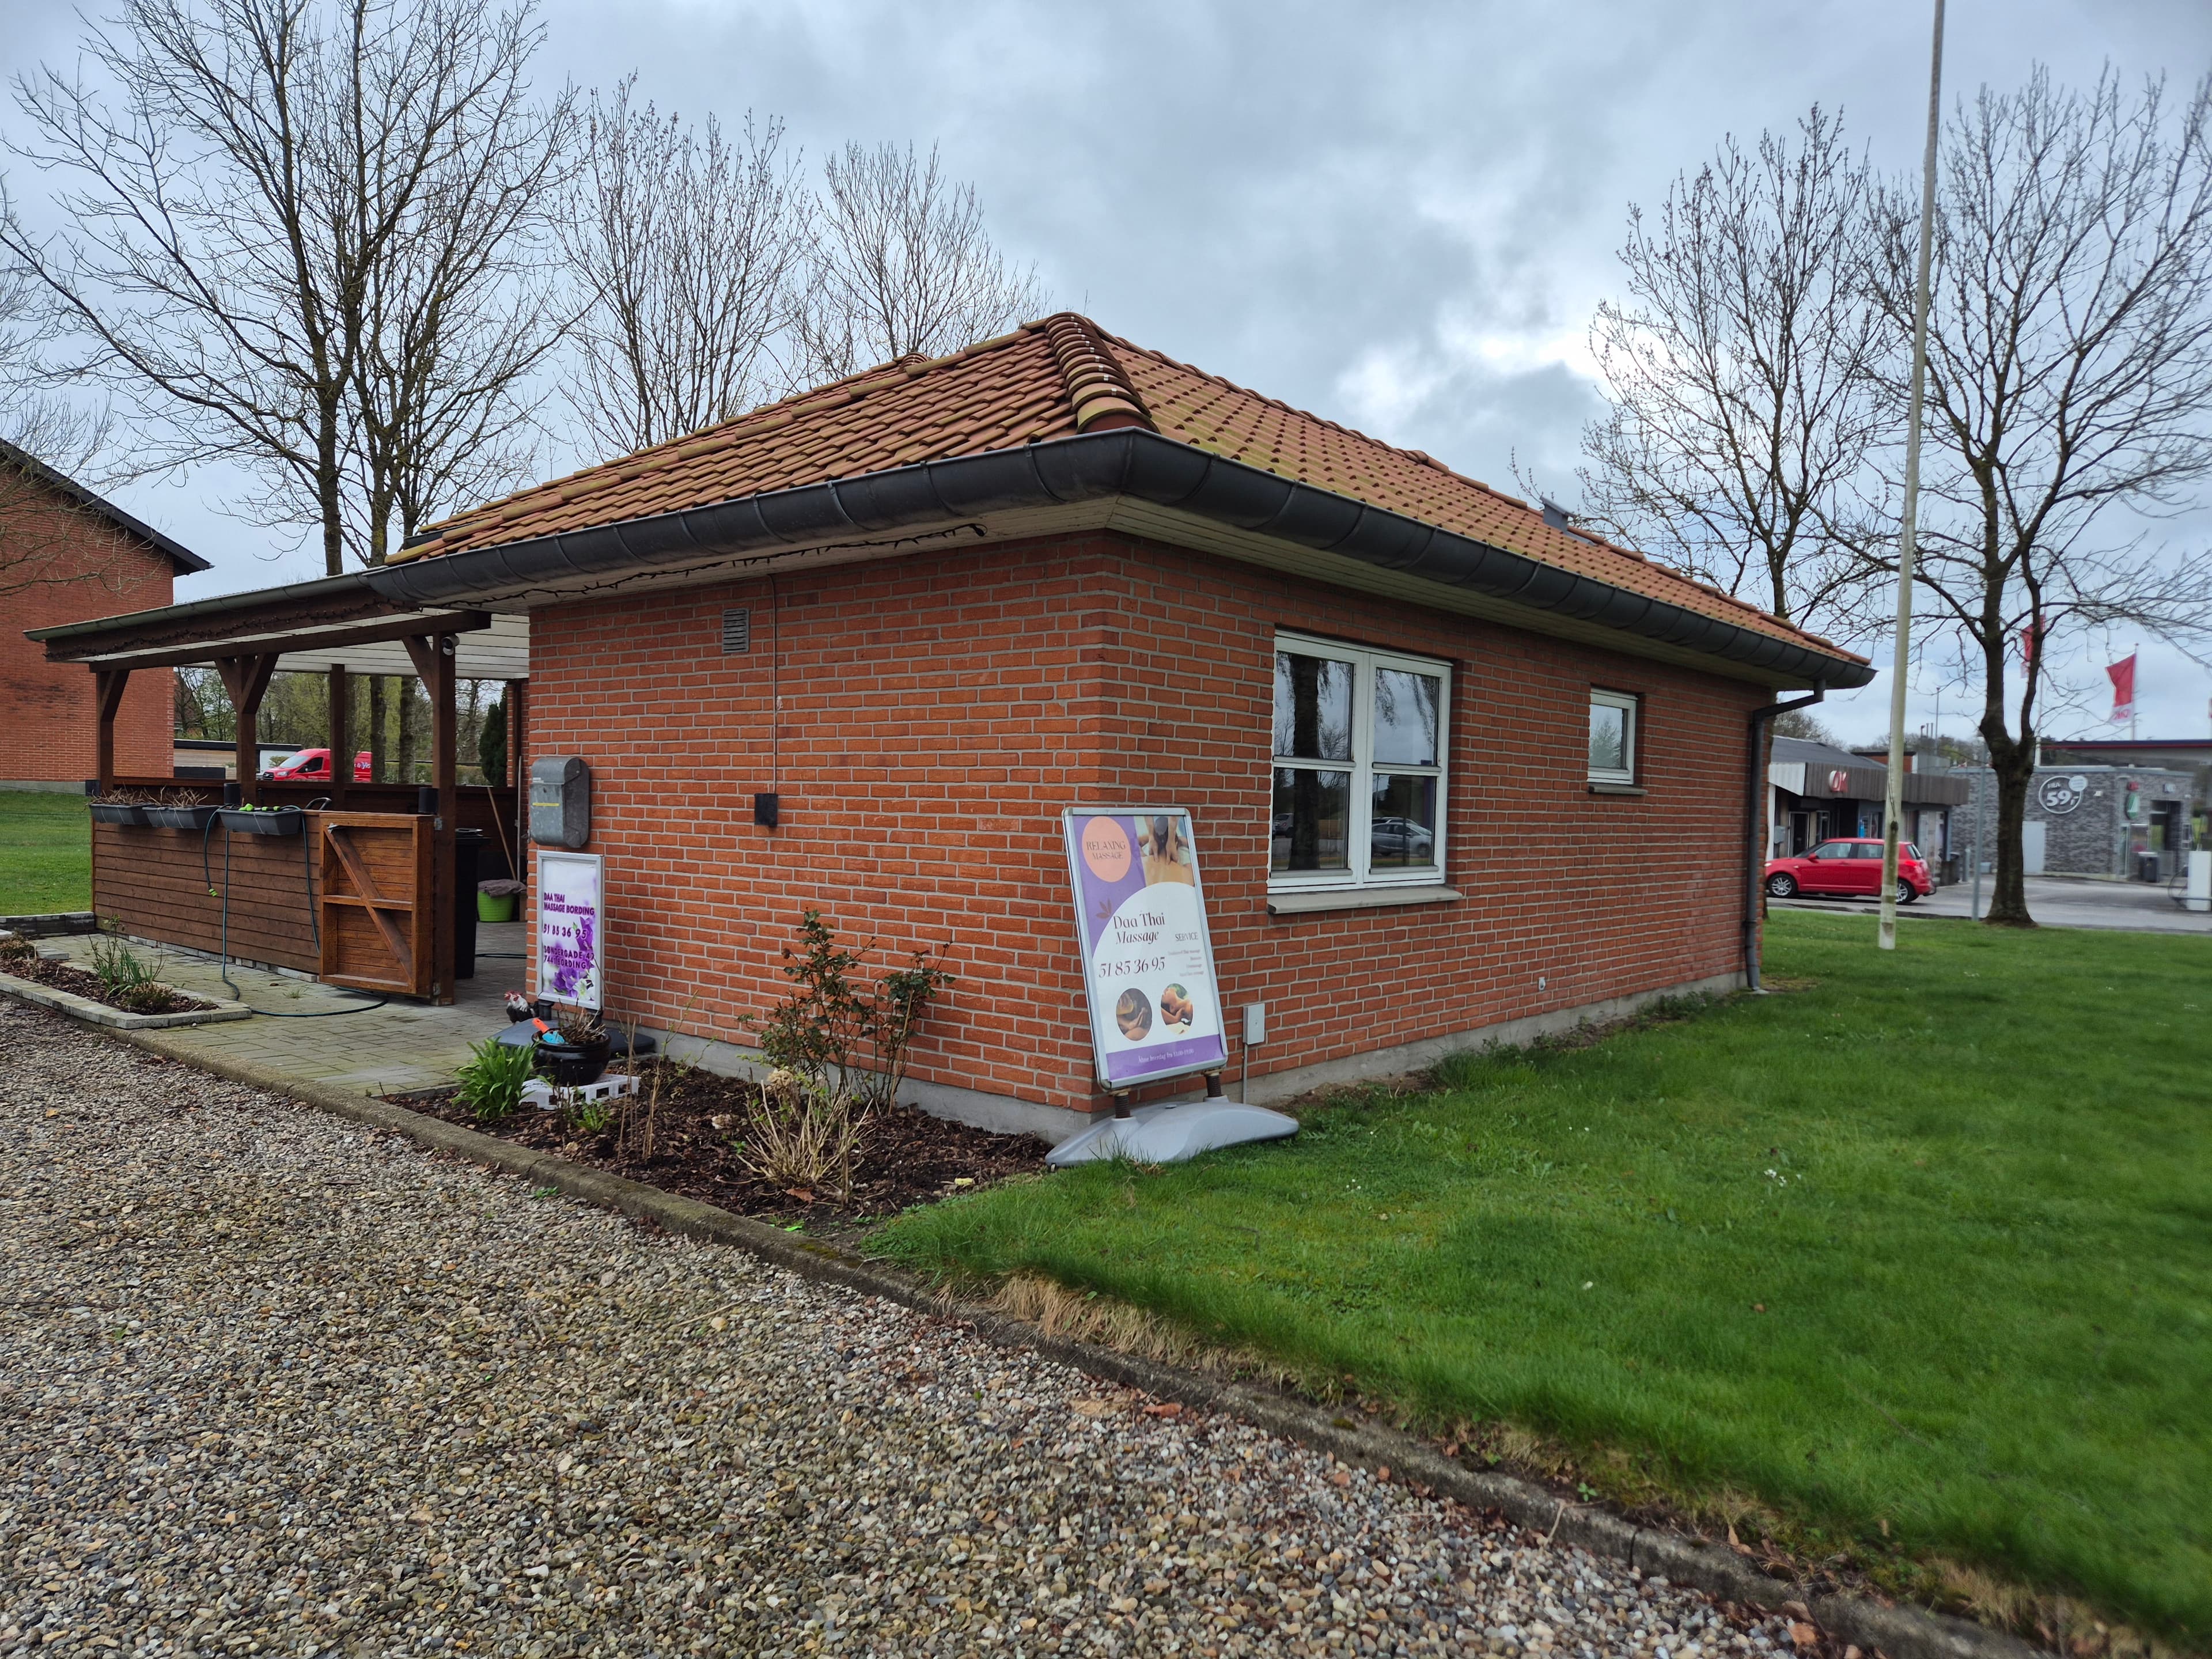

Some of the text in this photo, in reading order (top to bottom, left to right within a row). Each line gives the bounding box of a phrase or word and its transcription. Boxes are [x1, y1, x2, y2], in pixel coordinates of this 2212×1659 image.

[1086, 840, 1126, 851] RELAXING
[1092, 851, 1123, 859] MASSAGE
[544, 892, 565, 903] DAA THAI
[544, 902, 594, 915] MASSAGE BORDING
[1113, 912, 1165, 929] Daa Thai
[544, 923, 587, 939] 51 85 36 95
[1175, 932, 1198, 941] SERVICE
[1116, 931, 1159, 945] Massage
[544, 945, 583, 959] SØNDERGADE
[558, 959, 586, 969] BORDING
[1099, 957, 1165, 978] 51 85 36 95
